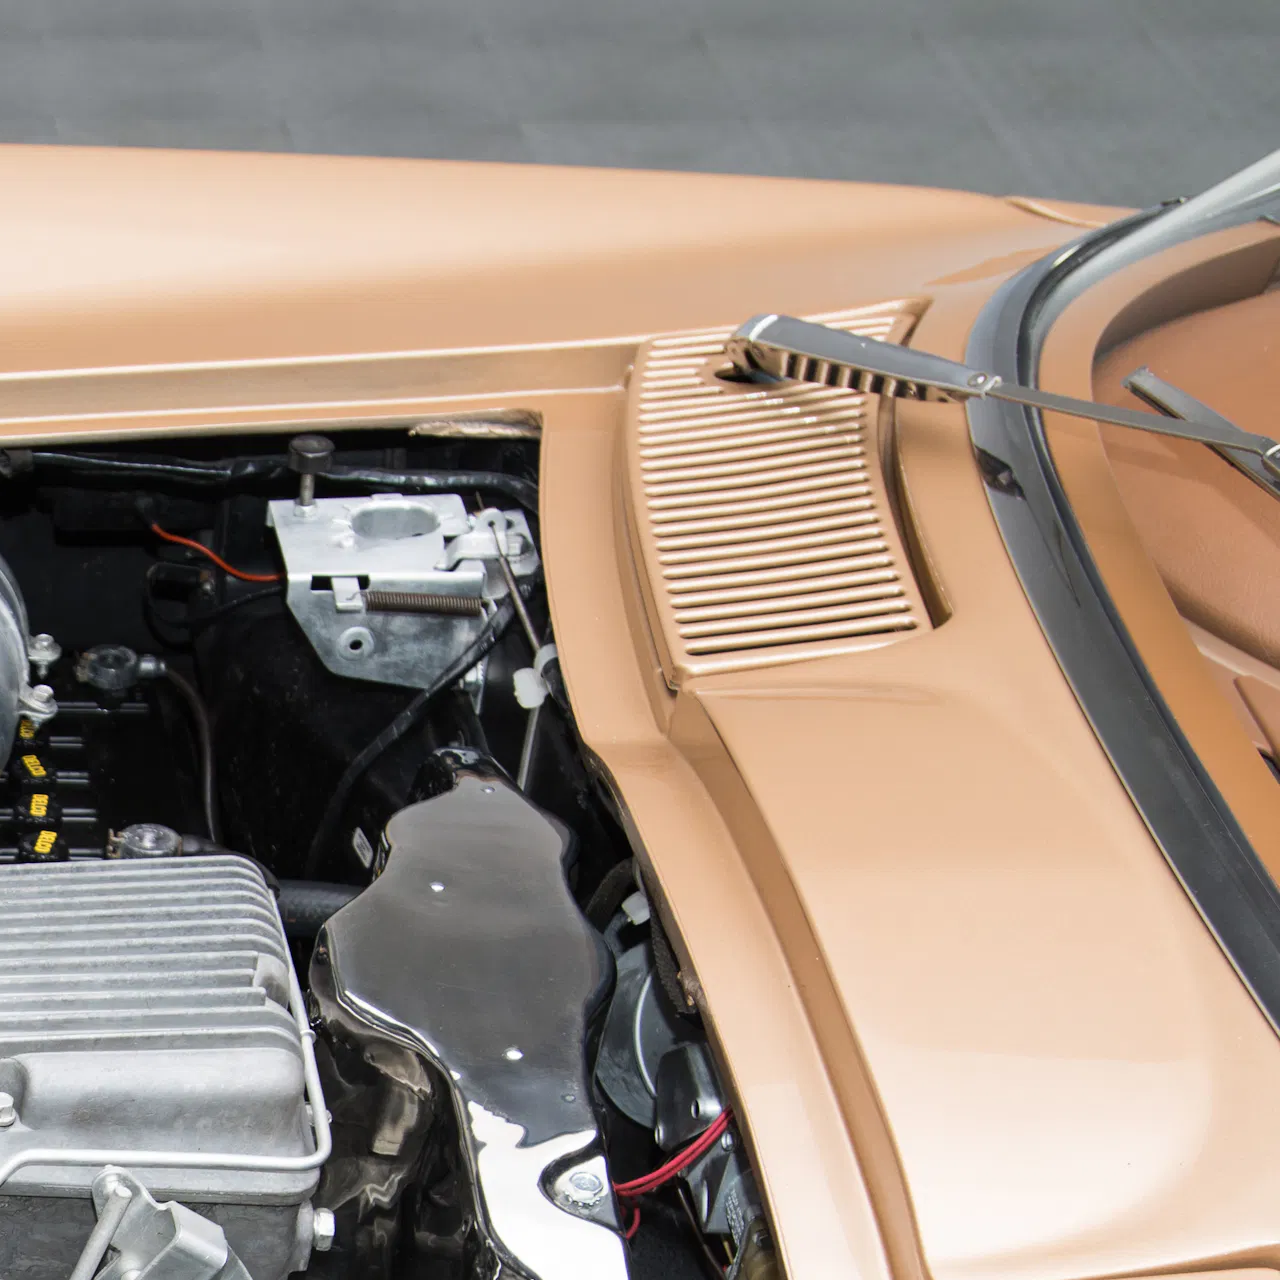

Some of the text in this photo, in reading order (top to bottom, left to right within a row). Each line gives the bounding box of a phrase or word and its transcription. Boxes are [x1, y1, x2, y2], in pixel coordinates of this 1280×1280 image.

[22, 754, 47, 777] DELCO
[29, 793, 49, 816] DELCO
[34, 830, 58, 854] DELCO
